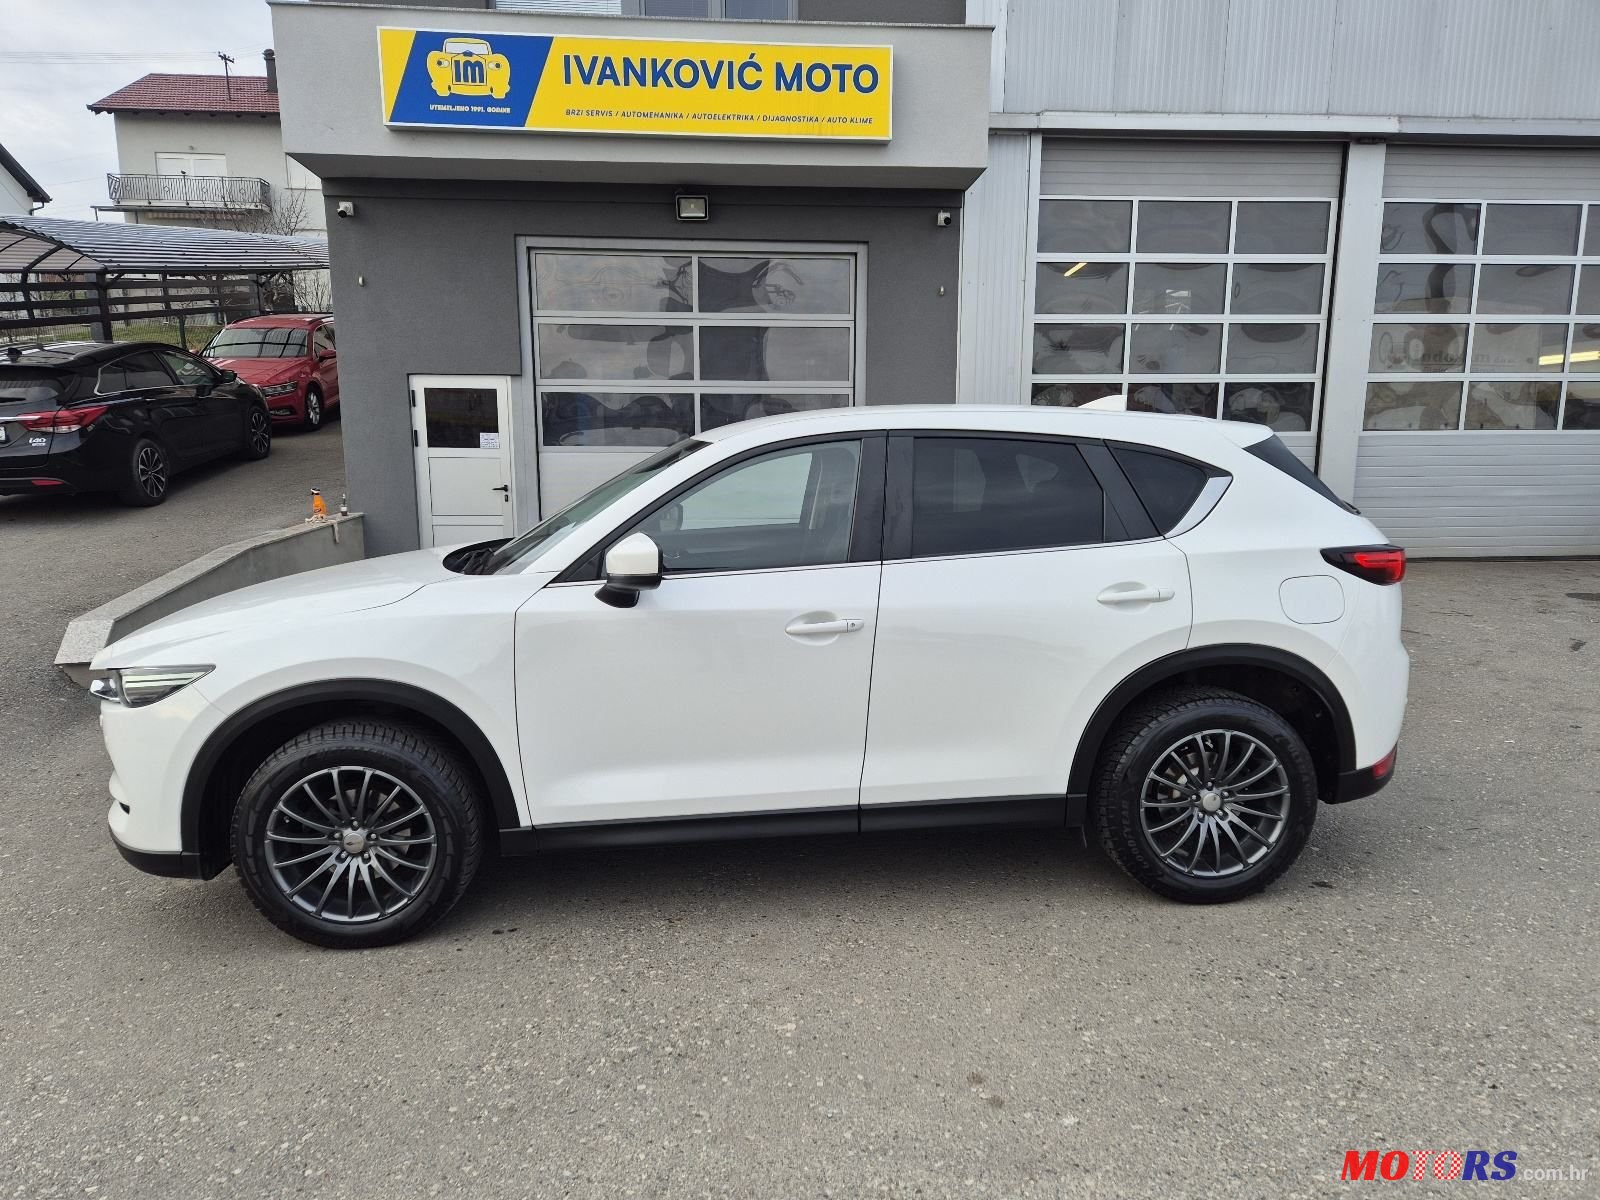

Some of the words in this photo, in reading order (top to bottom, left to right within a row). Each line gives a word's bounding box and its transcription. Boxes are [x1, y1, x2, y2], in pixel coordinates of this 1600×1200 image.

[563, 53, 762, 91] IVANKOVIĆ
[775, 62, 880, 94] MOTO
[621, 111, 684, 119] AUTOMEHANIKA
[692, 113, 755, 121] AUTOELEKTRIKA
[762, 115, 819, 123] DIJAGNOSTIKA
